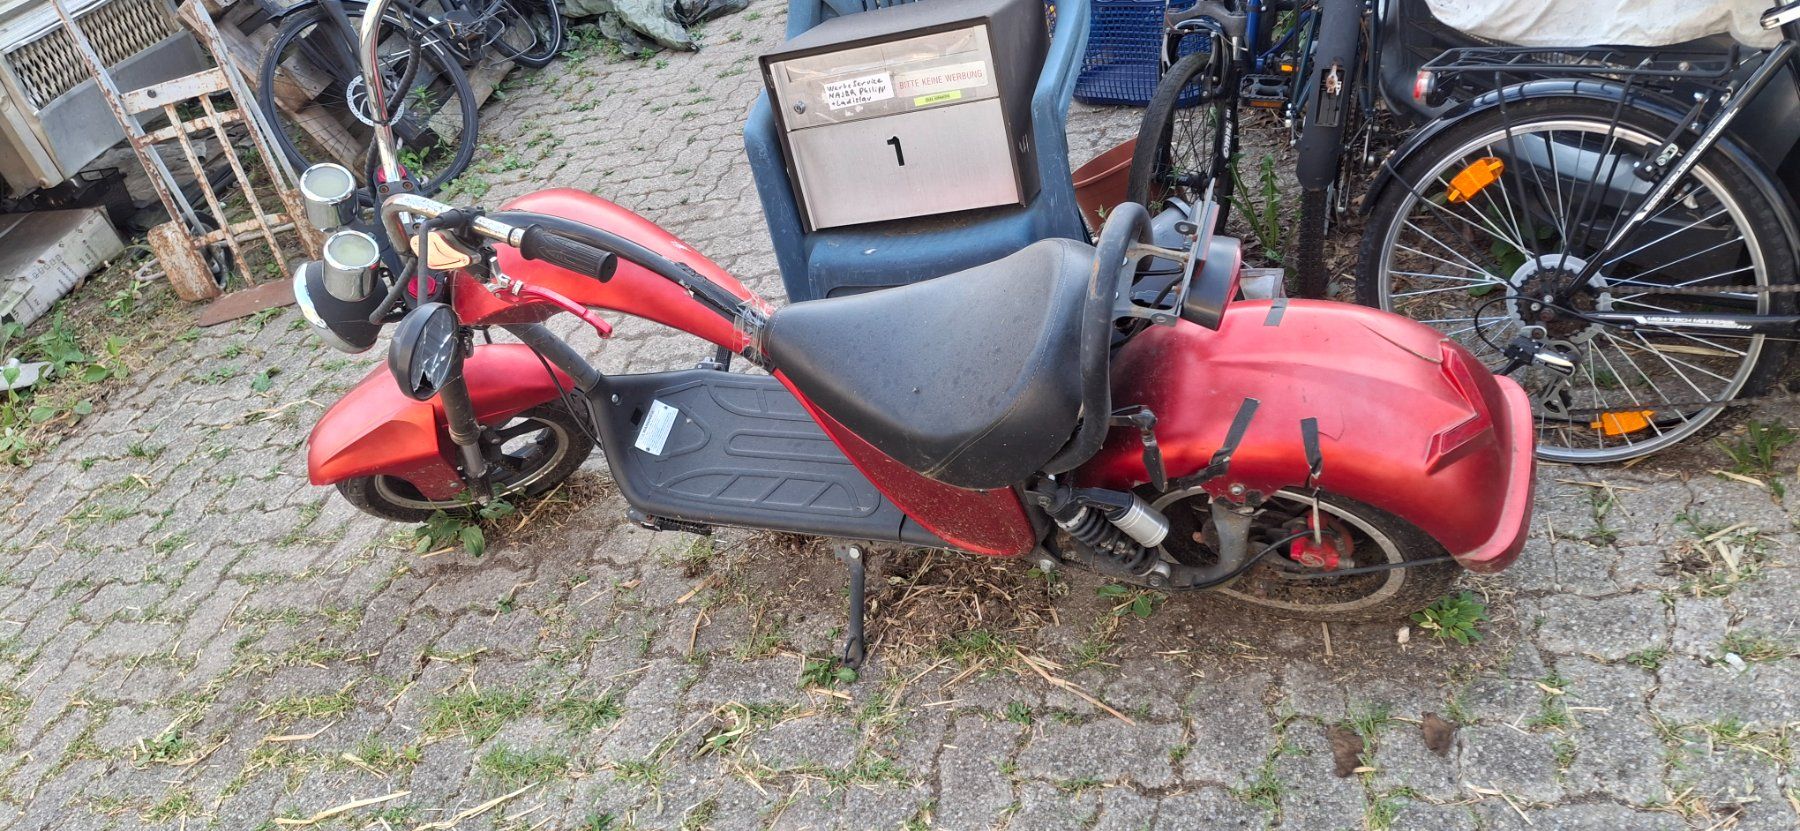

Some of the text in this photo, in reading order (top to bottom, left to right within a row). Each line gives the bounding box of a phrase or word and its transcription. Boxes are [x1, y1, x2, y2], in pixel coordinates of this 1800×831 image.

[900, 69, 983, 90] BITTE KEINE WERBUNG
[887, 136, 905, 166] 1
